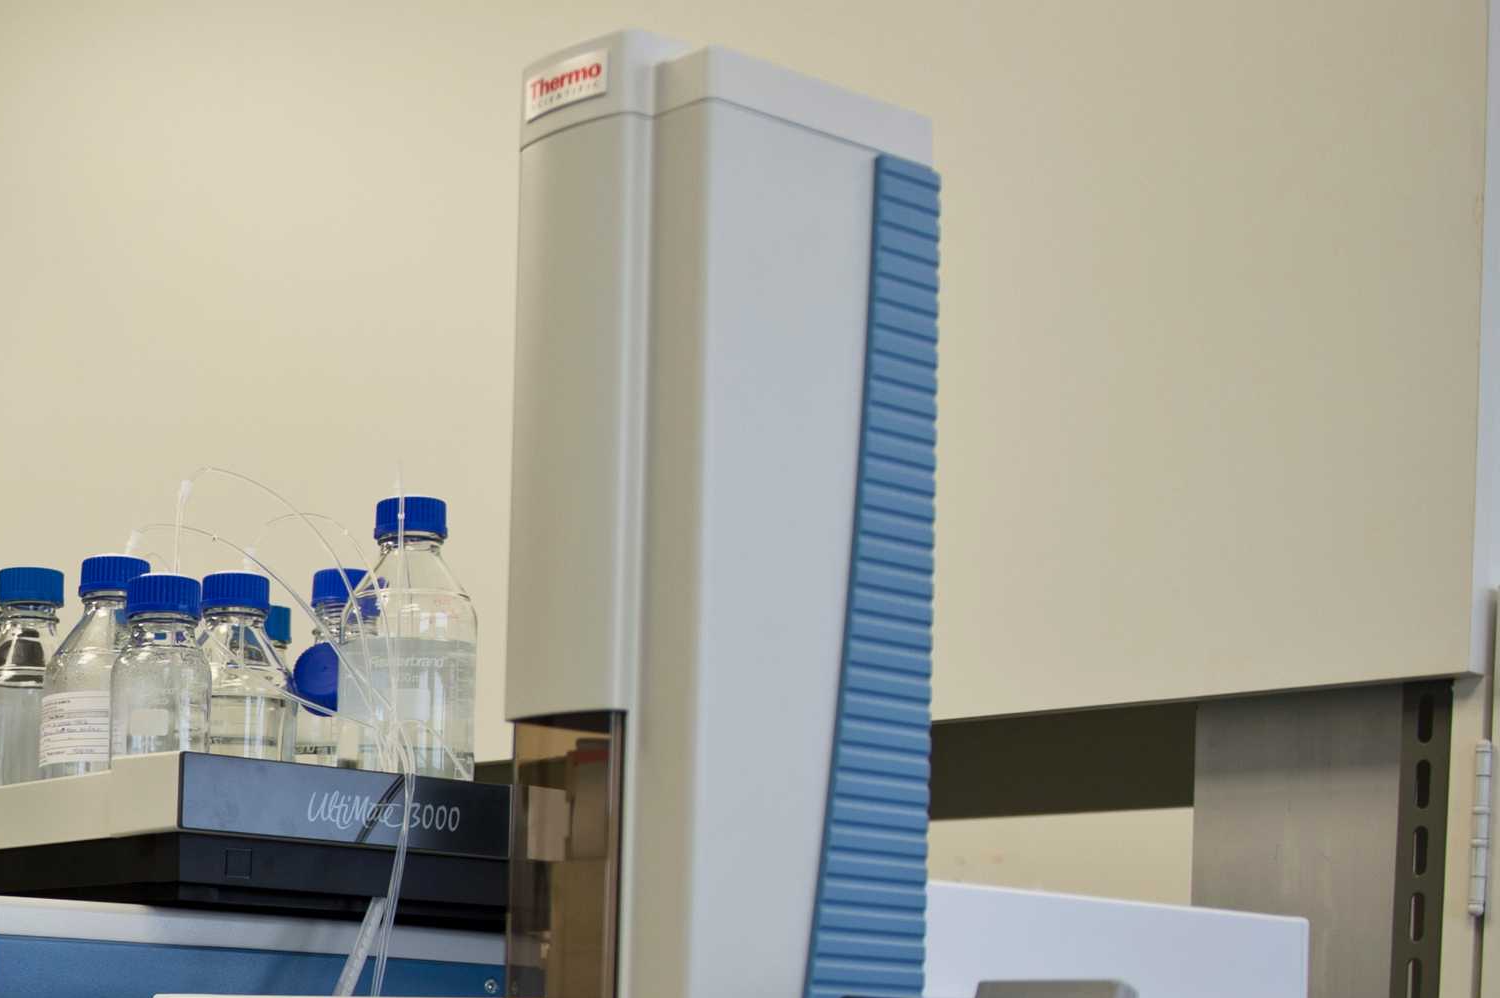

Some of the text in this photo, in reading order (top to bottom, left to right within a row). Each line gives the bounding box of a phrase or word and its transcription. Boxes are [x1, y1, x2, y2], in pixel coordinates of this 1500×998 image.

[530, 62, 602, 102] Thermo
[307, 790, 461, 834] UltiMate 3000
